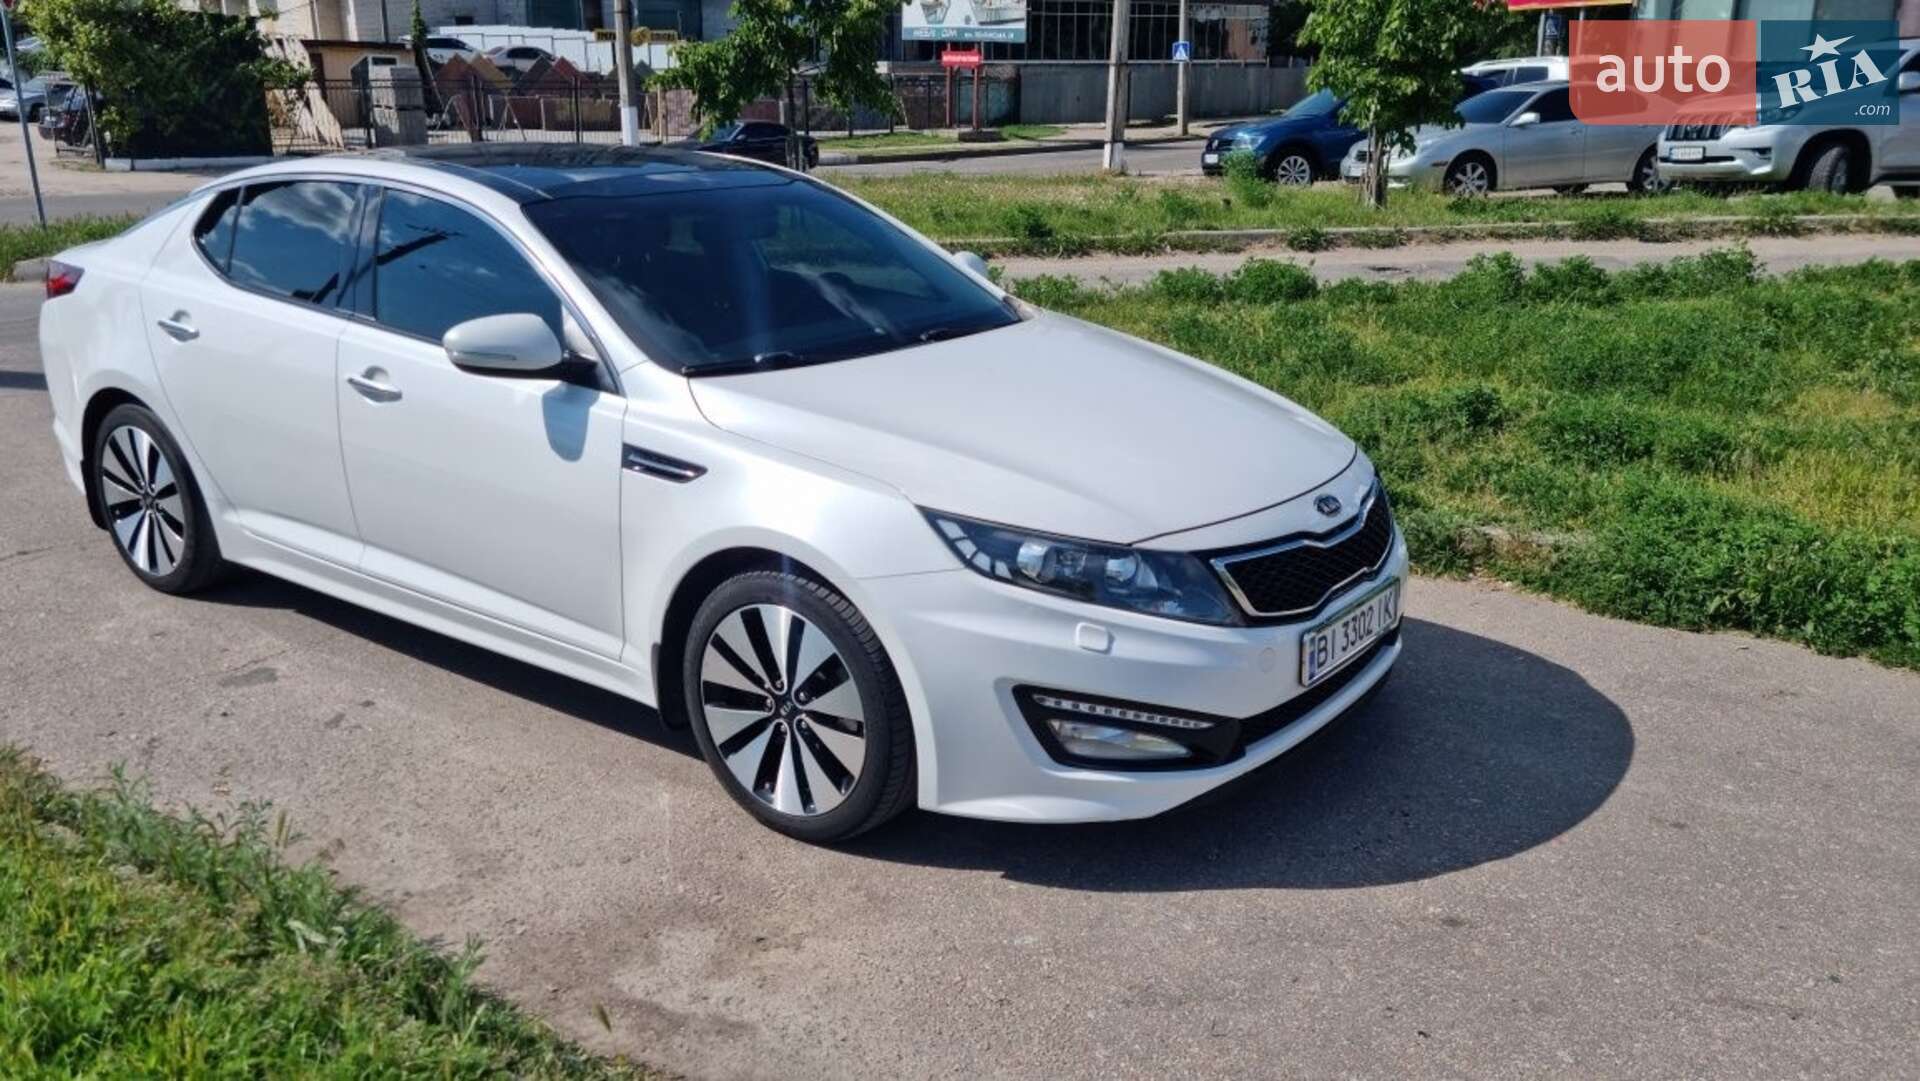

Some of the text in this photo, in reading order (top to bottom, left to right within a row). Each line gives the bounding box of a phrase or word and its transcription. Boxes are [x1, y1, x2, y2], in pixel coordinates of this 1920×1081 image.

[1316, 590, 1393, 669] BI 3302 IK
